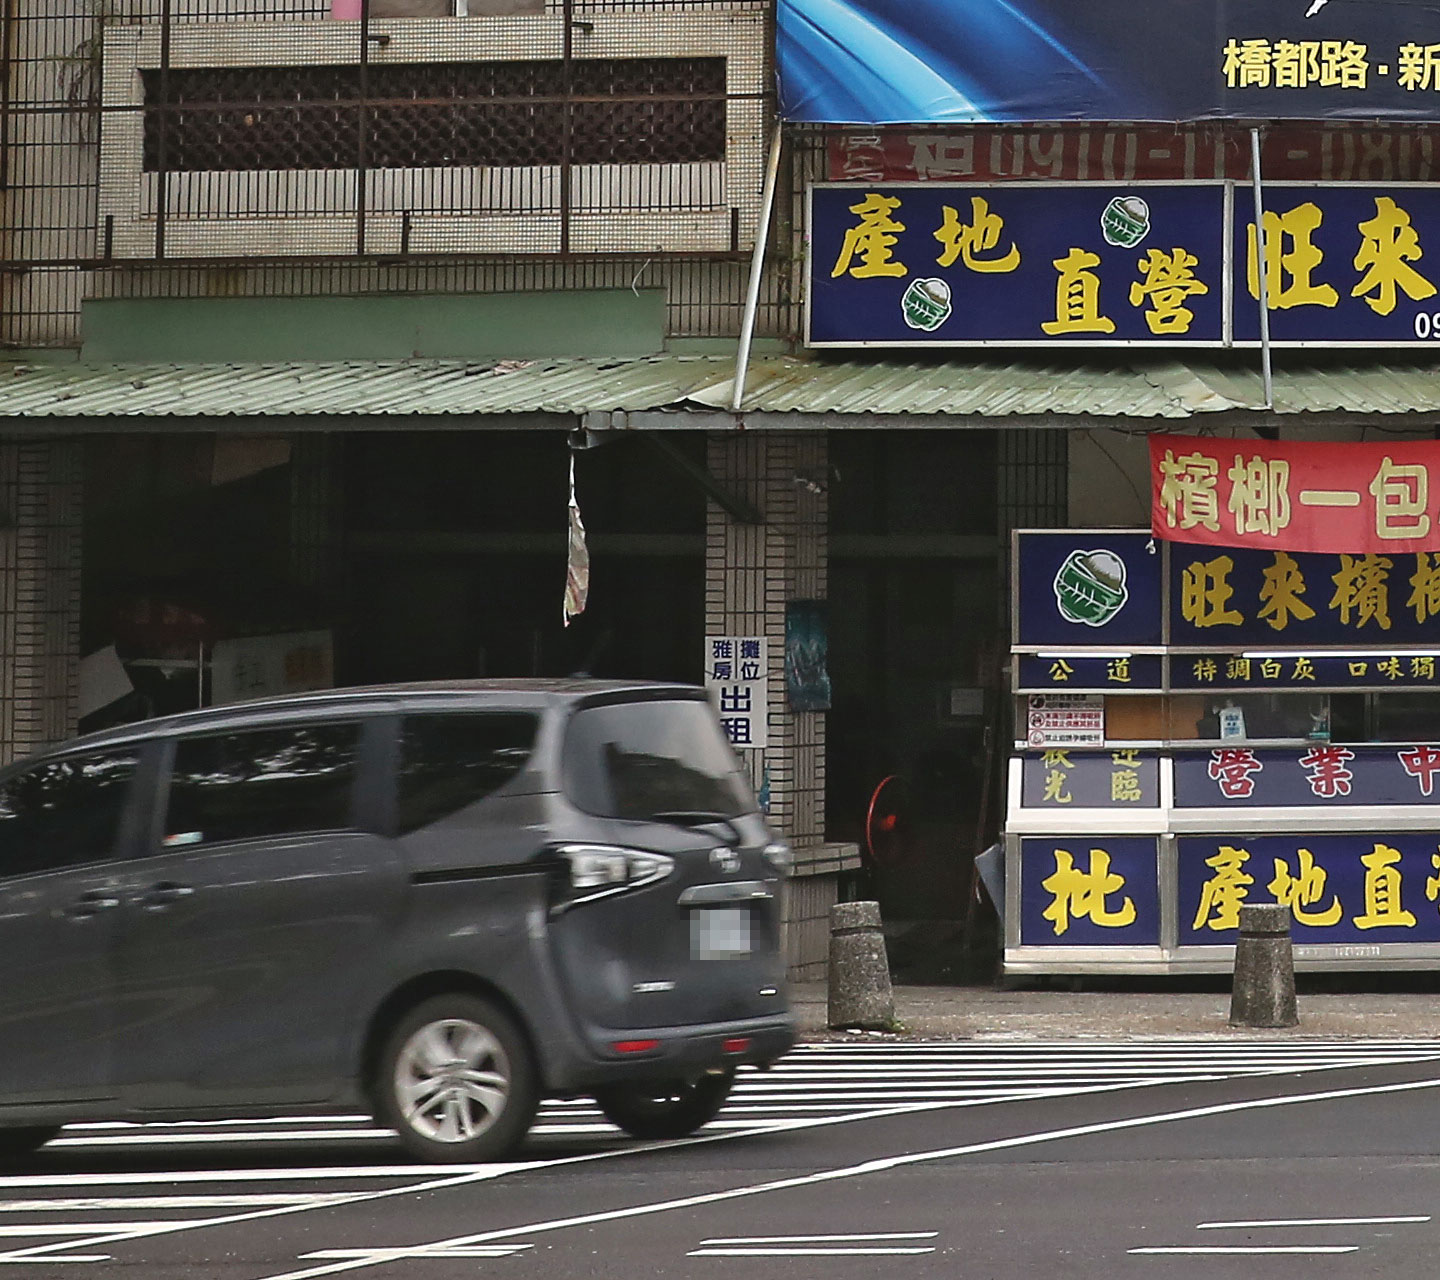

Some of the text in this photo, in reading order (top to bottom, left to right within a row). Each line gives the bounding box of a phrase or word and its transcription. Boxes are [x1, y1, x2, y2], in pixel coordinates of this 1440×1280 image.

[830, 192, 1208, 340] 產地 直營
[712, 639, 733, 680] 雅房
[740, 639, 761, 680] 攤位
[1193, 656, 1317, 683] 特調白灰
[720, 685, 753, 745] 出租
[1042, 770, 1142, 804] 光臨
[1041, 848, 1138, 937] 批
